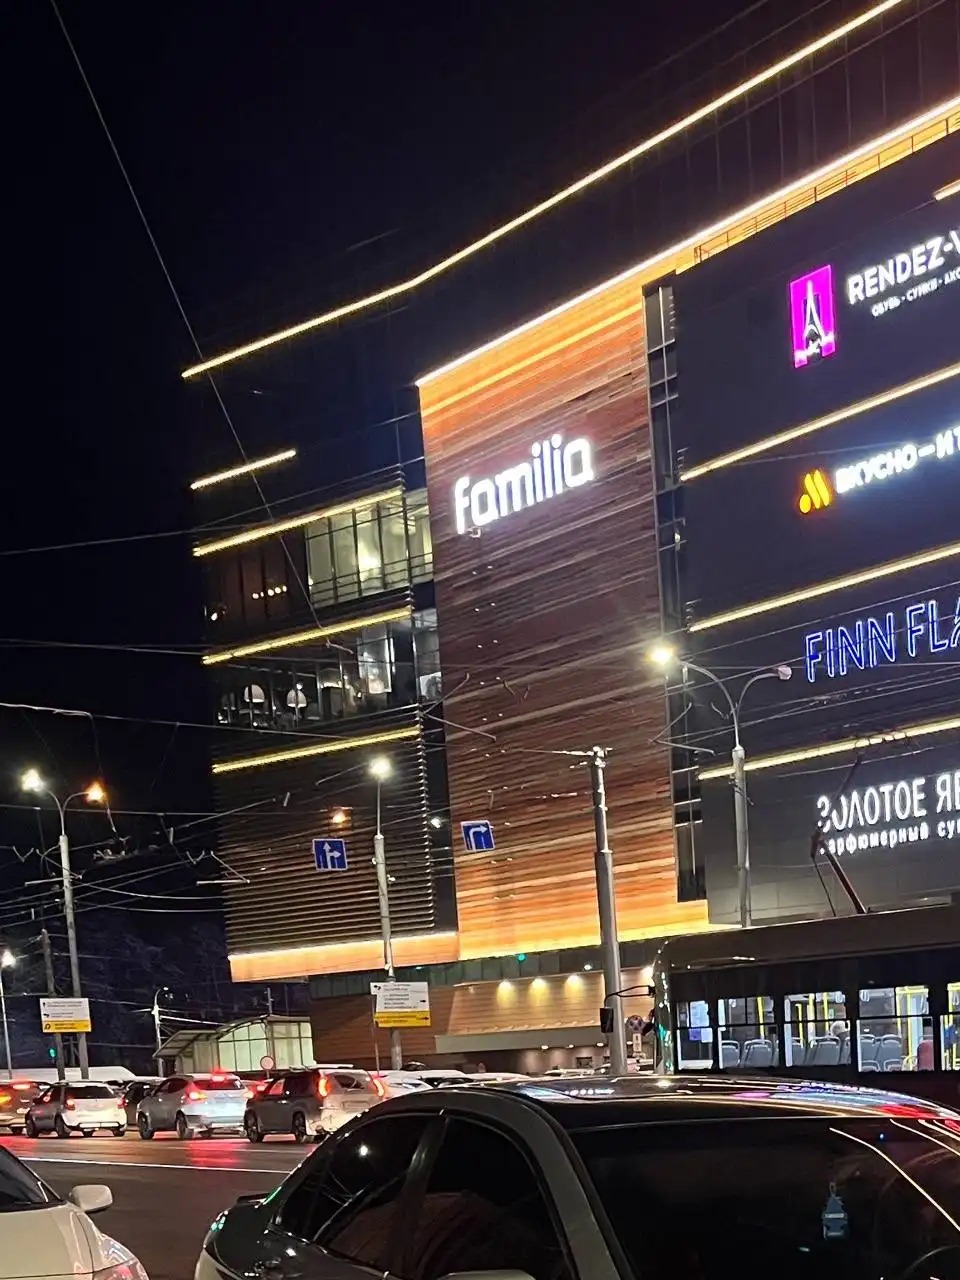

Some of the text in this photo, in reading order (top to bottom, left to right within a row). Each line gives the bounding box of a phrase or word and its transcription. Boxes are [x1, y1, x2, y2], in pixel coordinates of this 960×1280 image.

[906, 277, 938, 302] СУМКИ
[455, 433, 594, 535] familia
[806, 612, 895, 683] FINN
[816, 777, 927, 833] ЗОЛОТОЕ
[820, 822, 929, 856] арфюмерный
